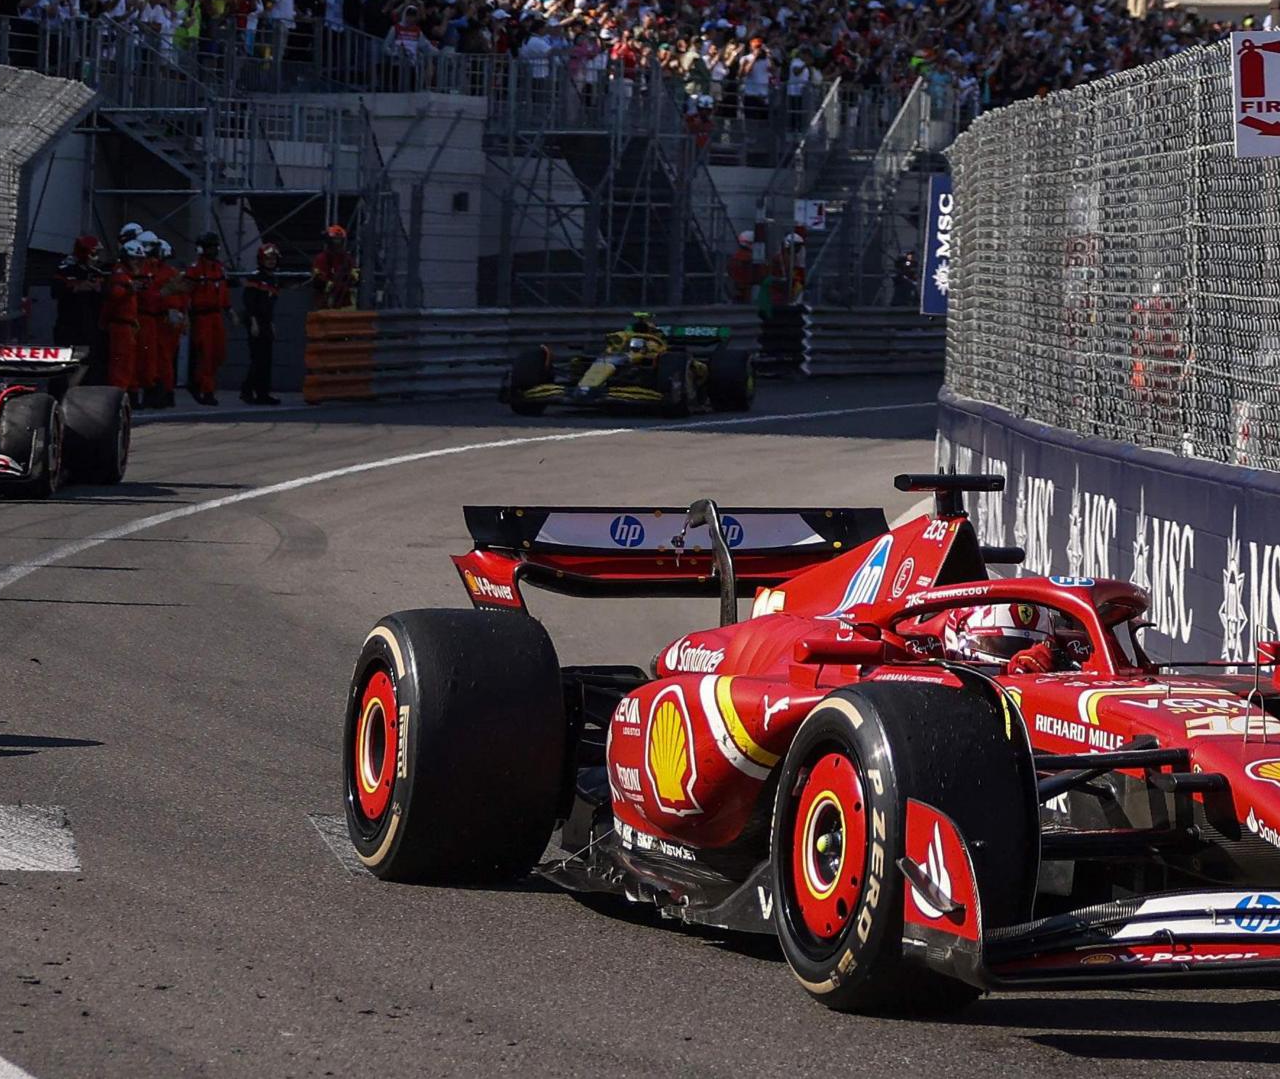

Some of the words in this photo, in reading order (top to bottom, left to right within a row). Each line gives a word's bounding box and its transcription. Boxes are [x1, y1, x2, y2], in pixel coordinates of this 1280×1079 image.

[935, 193, 954, 258] MSC
[612, 516, 643, 547] hp
[476, 576, 514, 600] V-Power
[928, 586, 989, 599] TECHNOLOGY
[1152, 517, 1194, 643] MSC
[678, 640, 725, 673] Santander
[1120, 698, 1253, 710] VGW
[1035, 714, 1086, 743] RICHARD
[1089, 728, 1124, 750] MILLE
[857, 808, 886, 944] ZERO
[1120, 952, 1259, 962] V-Power
